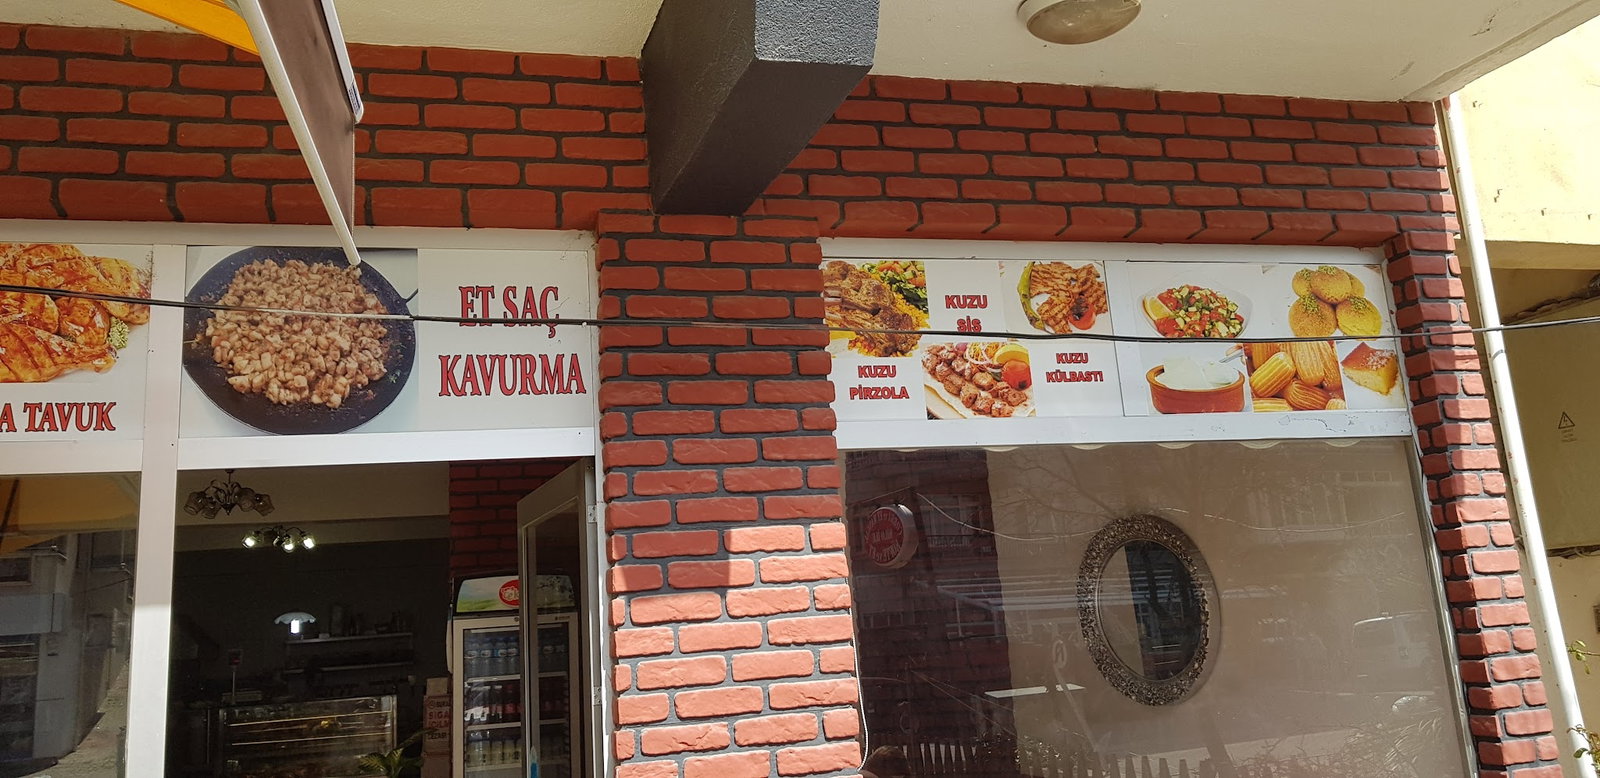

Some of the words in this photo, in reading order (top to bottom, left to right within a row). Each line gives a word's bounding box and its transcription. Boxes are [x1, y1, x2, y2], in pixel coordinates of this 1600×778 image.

[944, 294, 988, 309] KUZU
[458, 285, 496, 328] ET
[502, 285, 560, 339] SAÇ
[1055, 352, 1089, 364] KUZU
[438, 353, 586, 397] KAVURMA
[857, 364, 897, 379] KUZU
[1045, 368, 1104, 383] KÜLBASTI
[849, 384, 910, 401] PİRZOLA
[22, 402, 117, 432] TAVUK
